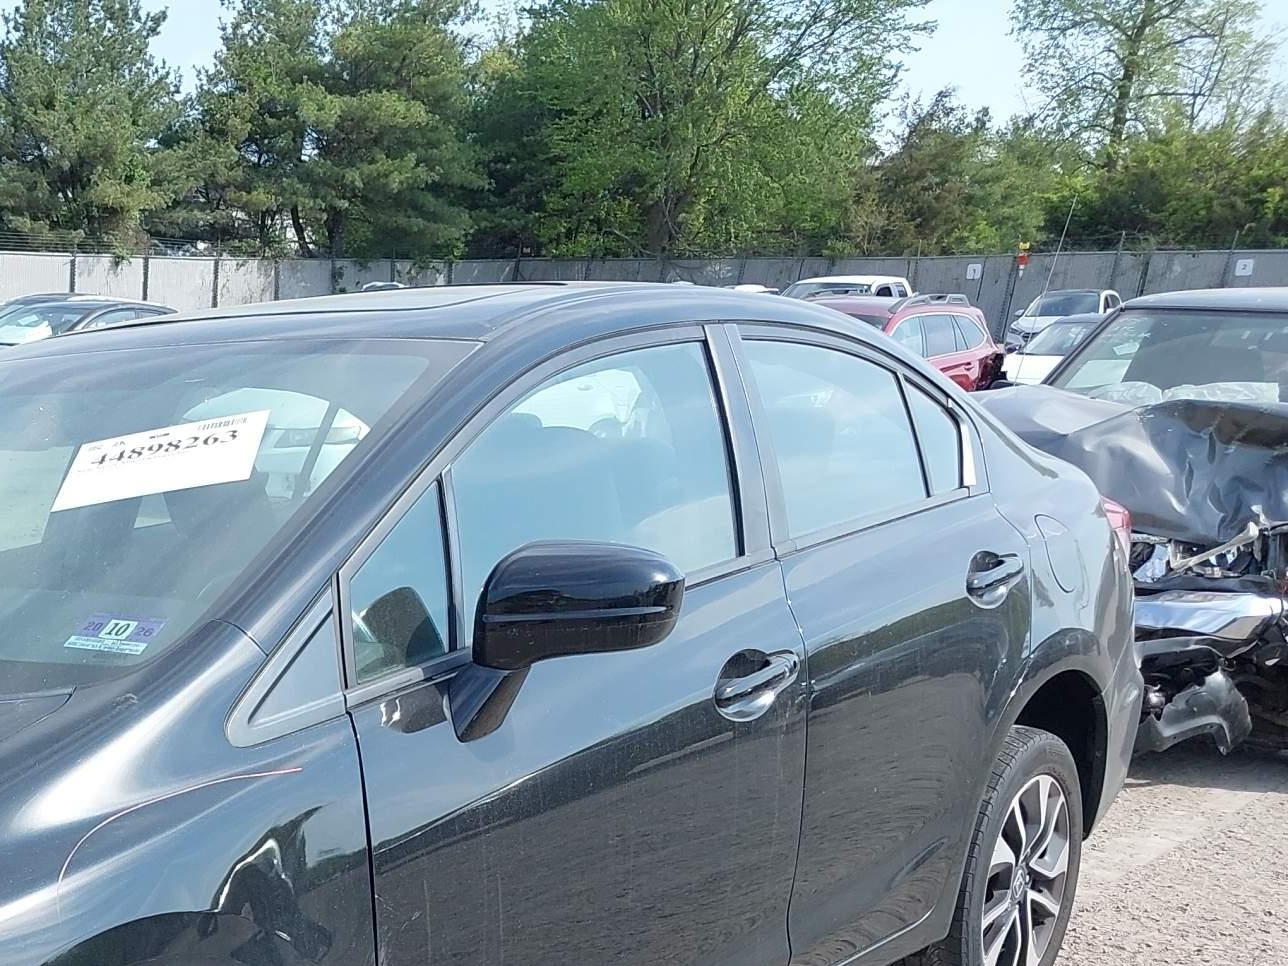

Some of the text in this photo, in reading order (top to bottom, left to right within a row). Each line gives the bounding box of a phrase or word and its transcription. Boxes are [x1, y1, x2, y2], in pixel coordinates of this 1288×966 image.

[91, 429, 238, 465] 44898263
[82, 622, 104, 632] 20
[105, 622, 131, 637] 10
